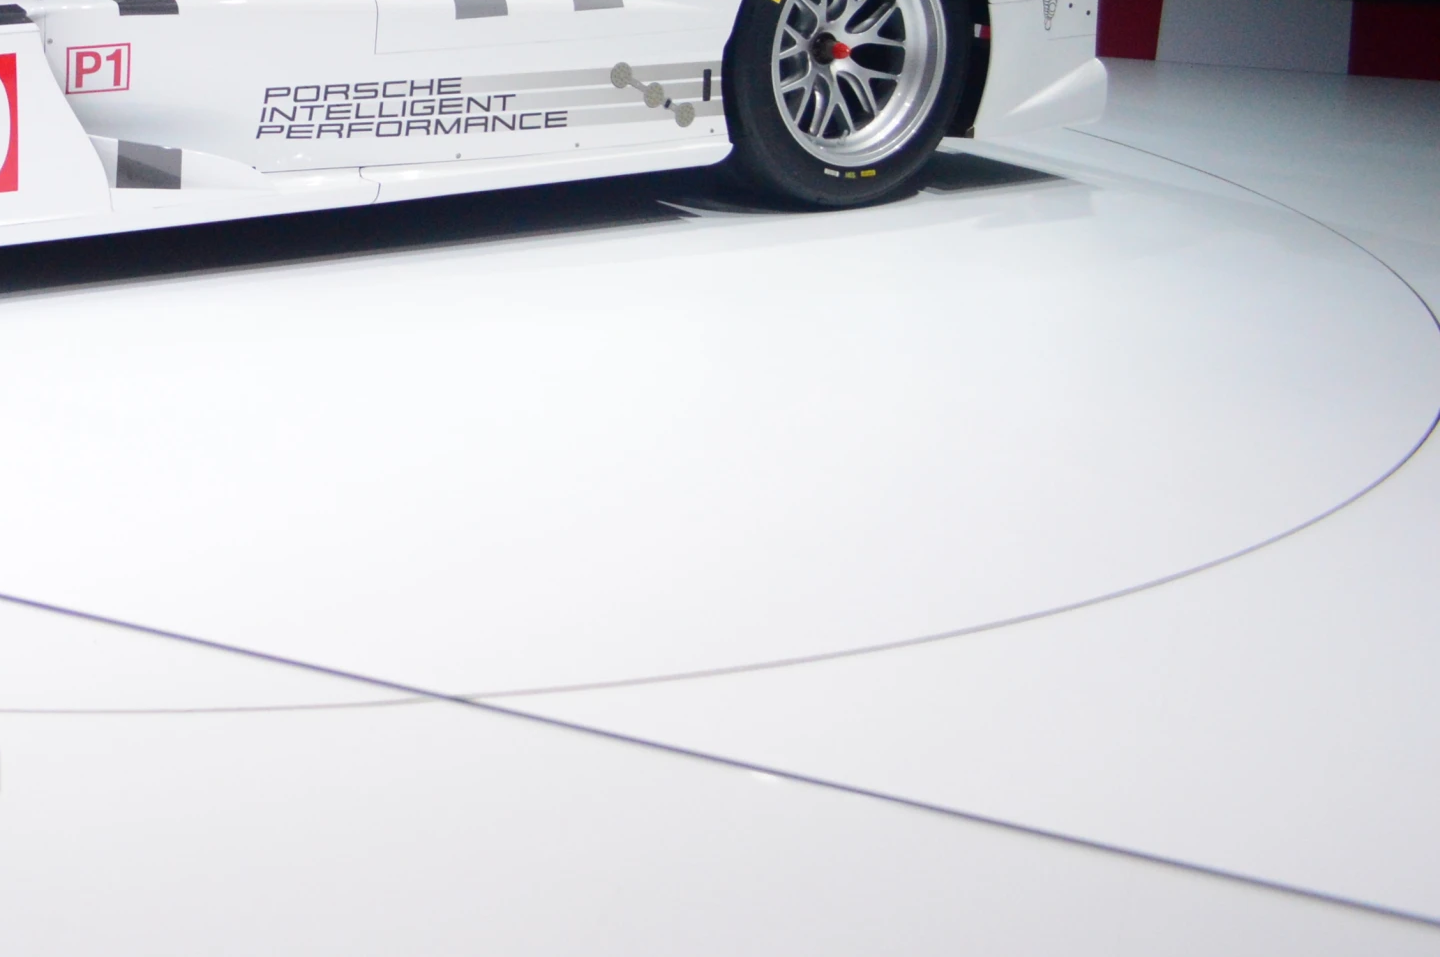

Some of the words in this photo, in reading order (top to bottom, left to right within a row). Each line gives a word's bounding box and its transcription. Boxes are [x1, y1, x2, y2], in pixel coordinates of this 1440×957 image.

[75, 48, 123, 89] P1
[263, 77, 463, 104] PORSCHE
[260, 94, 517, 123] INTELLIGENT
[256, 110, 569, 139] PERFORMANCE
